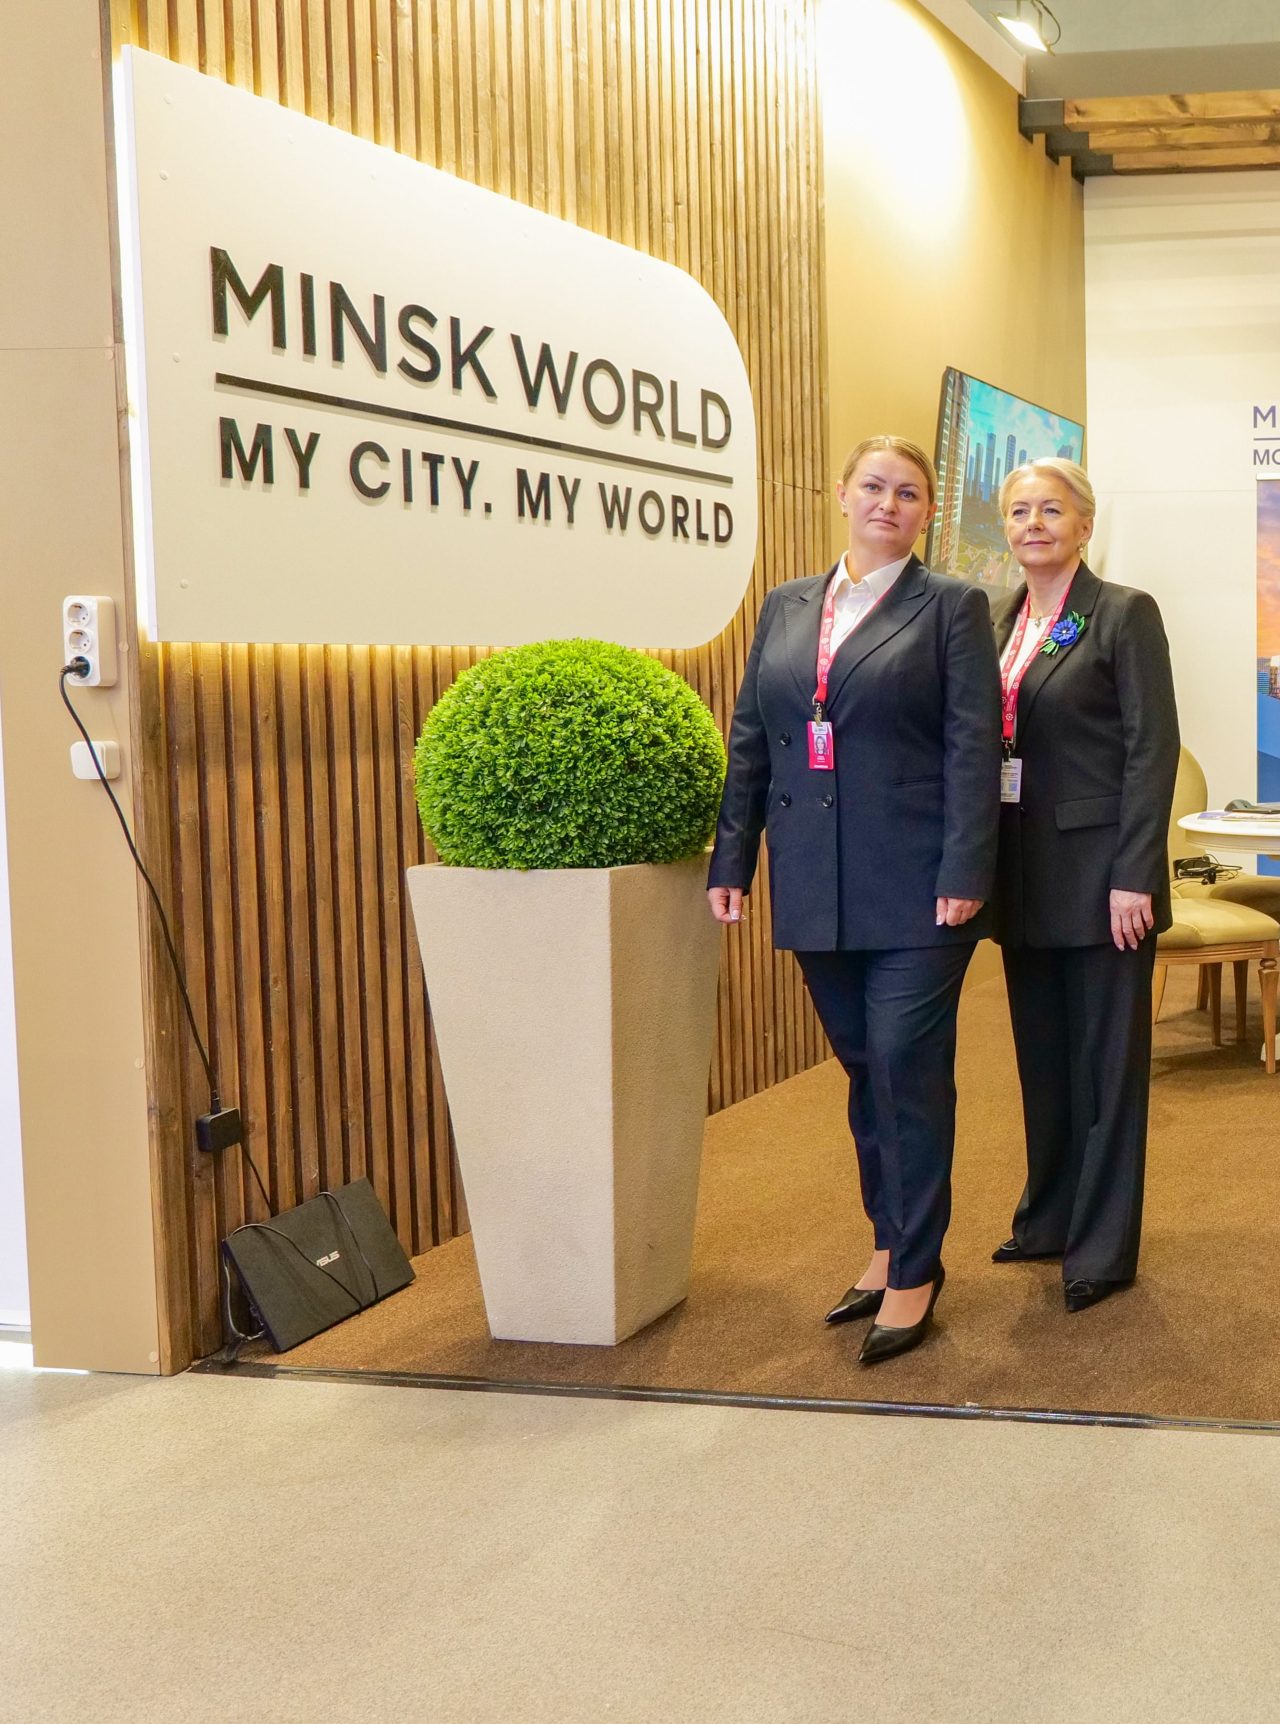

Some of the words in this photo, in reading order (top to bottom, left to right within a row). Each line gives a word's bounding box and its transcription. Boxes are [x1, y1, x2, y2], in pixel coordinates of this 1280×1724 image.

[209, 246, 498, 399] MINSK
[510, 333, 733, 449] WORLD
[218, 416, 321, 490] MY
[349, 441, 493, 514] CITY.
[516, 468, 581, 524] MY
[598, 481, 734, 544] WORLD
[316, 1250, 340, 1267] ASUS
